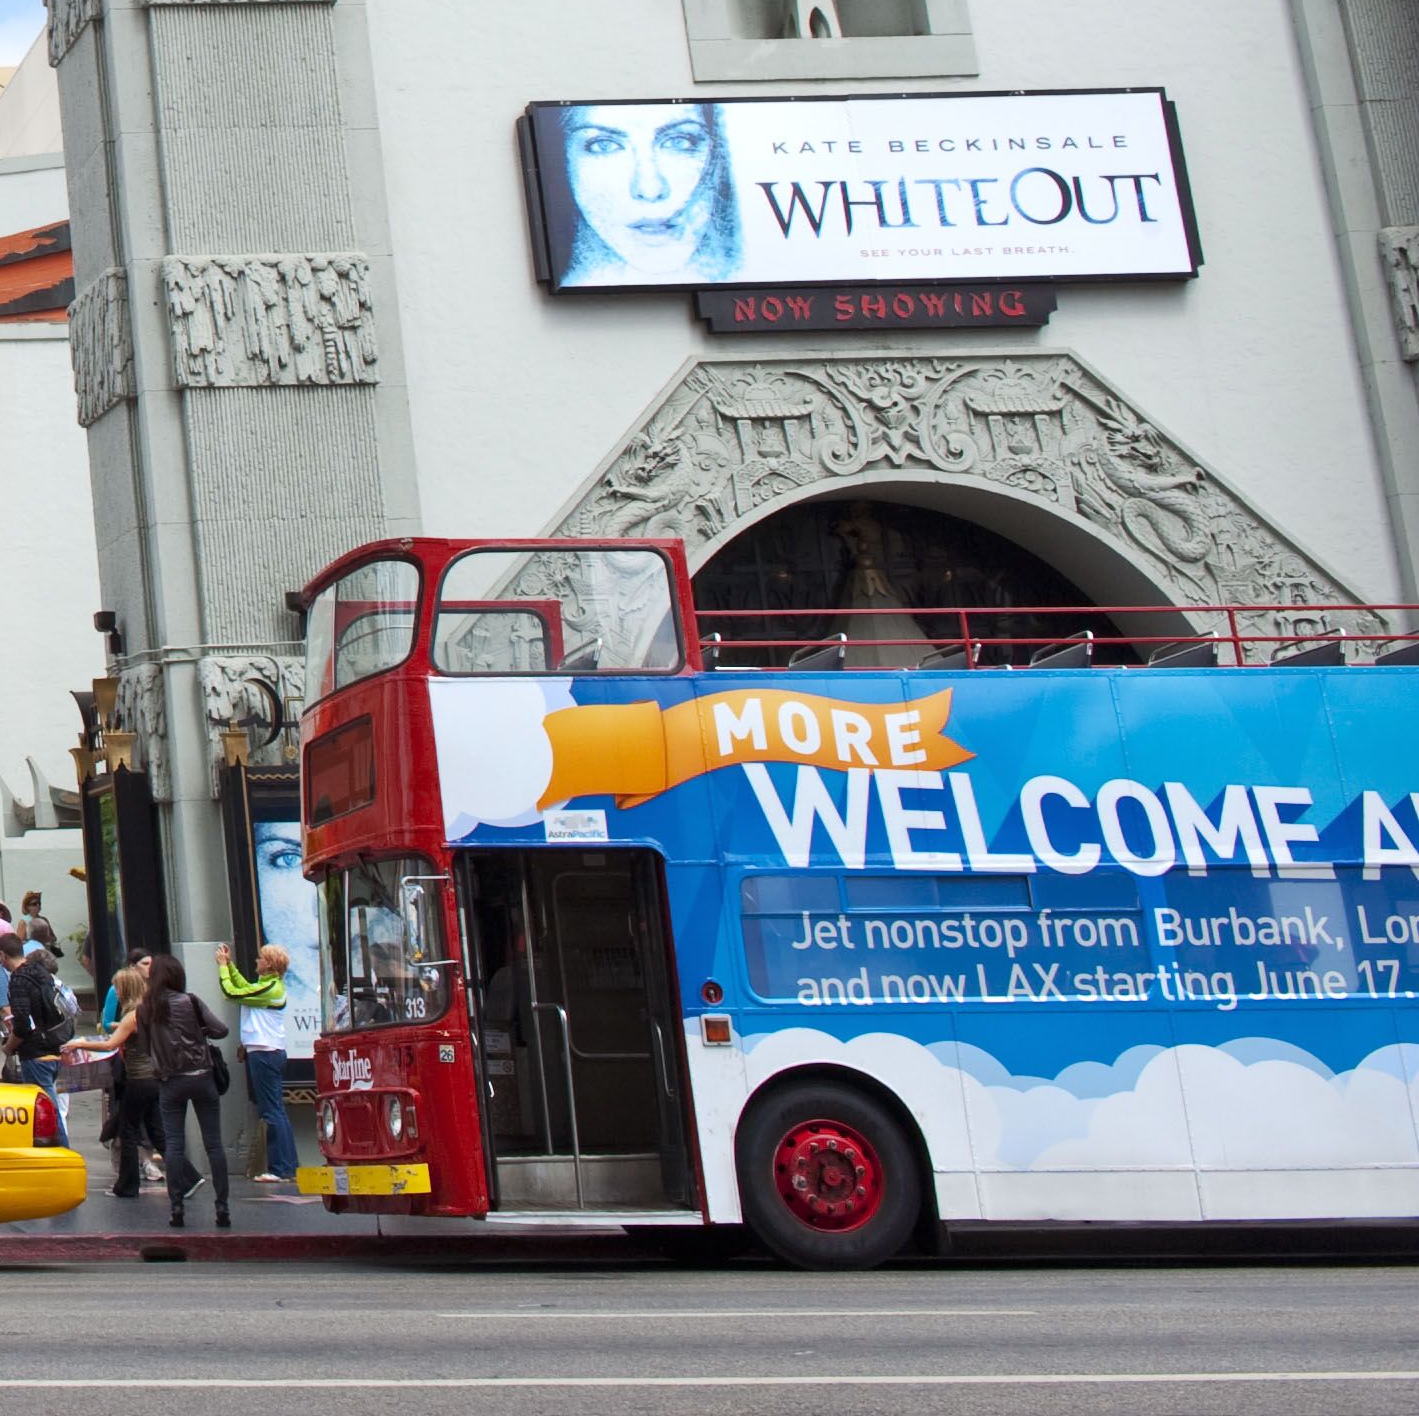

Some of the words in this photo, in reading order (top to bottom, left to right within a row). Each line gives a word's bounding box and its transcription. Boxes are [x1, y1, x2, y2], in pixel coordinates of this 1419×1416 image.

[772, 140, 863, 155] KATE
[889, 135, 1128, 153] BECKINSALE
[755, 167, 1162, 239] WHITEOUT
[860, 248, 890, 258] SEE
[899, 247, 943, 257] YOUR
[951, 246, 994, 256] LAST
[732, 295, 815, 322] NOW
[834, 290, 1027, 321] SHOWING
[713, 698, 927, 766] MORE
[740, 762, 1337, 880] WELCOME
[1362, 790, 1419, 881] A
[791, 910, 855, 949] Jet
[864, 913, 1028, 958] nonstop
[1037, 909, 1140, 947] from
[1154, 905, 1345, 952] Burbank,
[796, 967, 873, 1007] and
[881, 973, 966, 1004] now
[976, 963, 1068, 1004] LAX
[1073, 961, 1238, 1012] starting
[1247, 960, 1348, 1001] June
[1357, 959, 1415, 1000] 17.
[405, 996, 426, 1018] 313
[440, 1049, 454, 1062] 26
